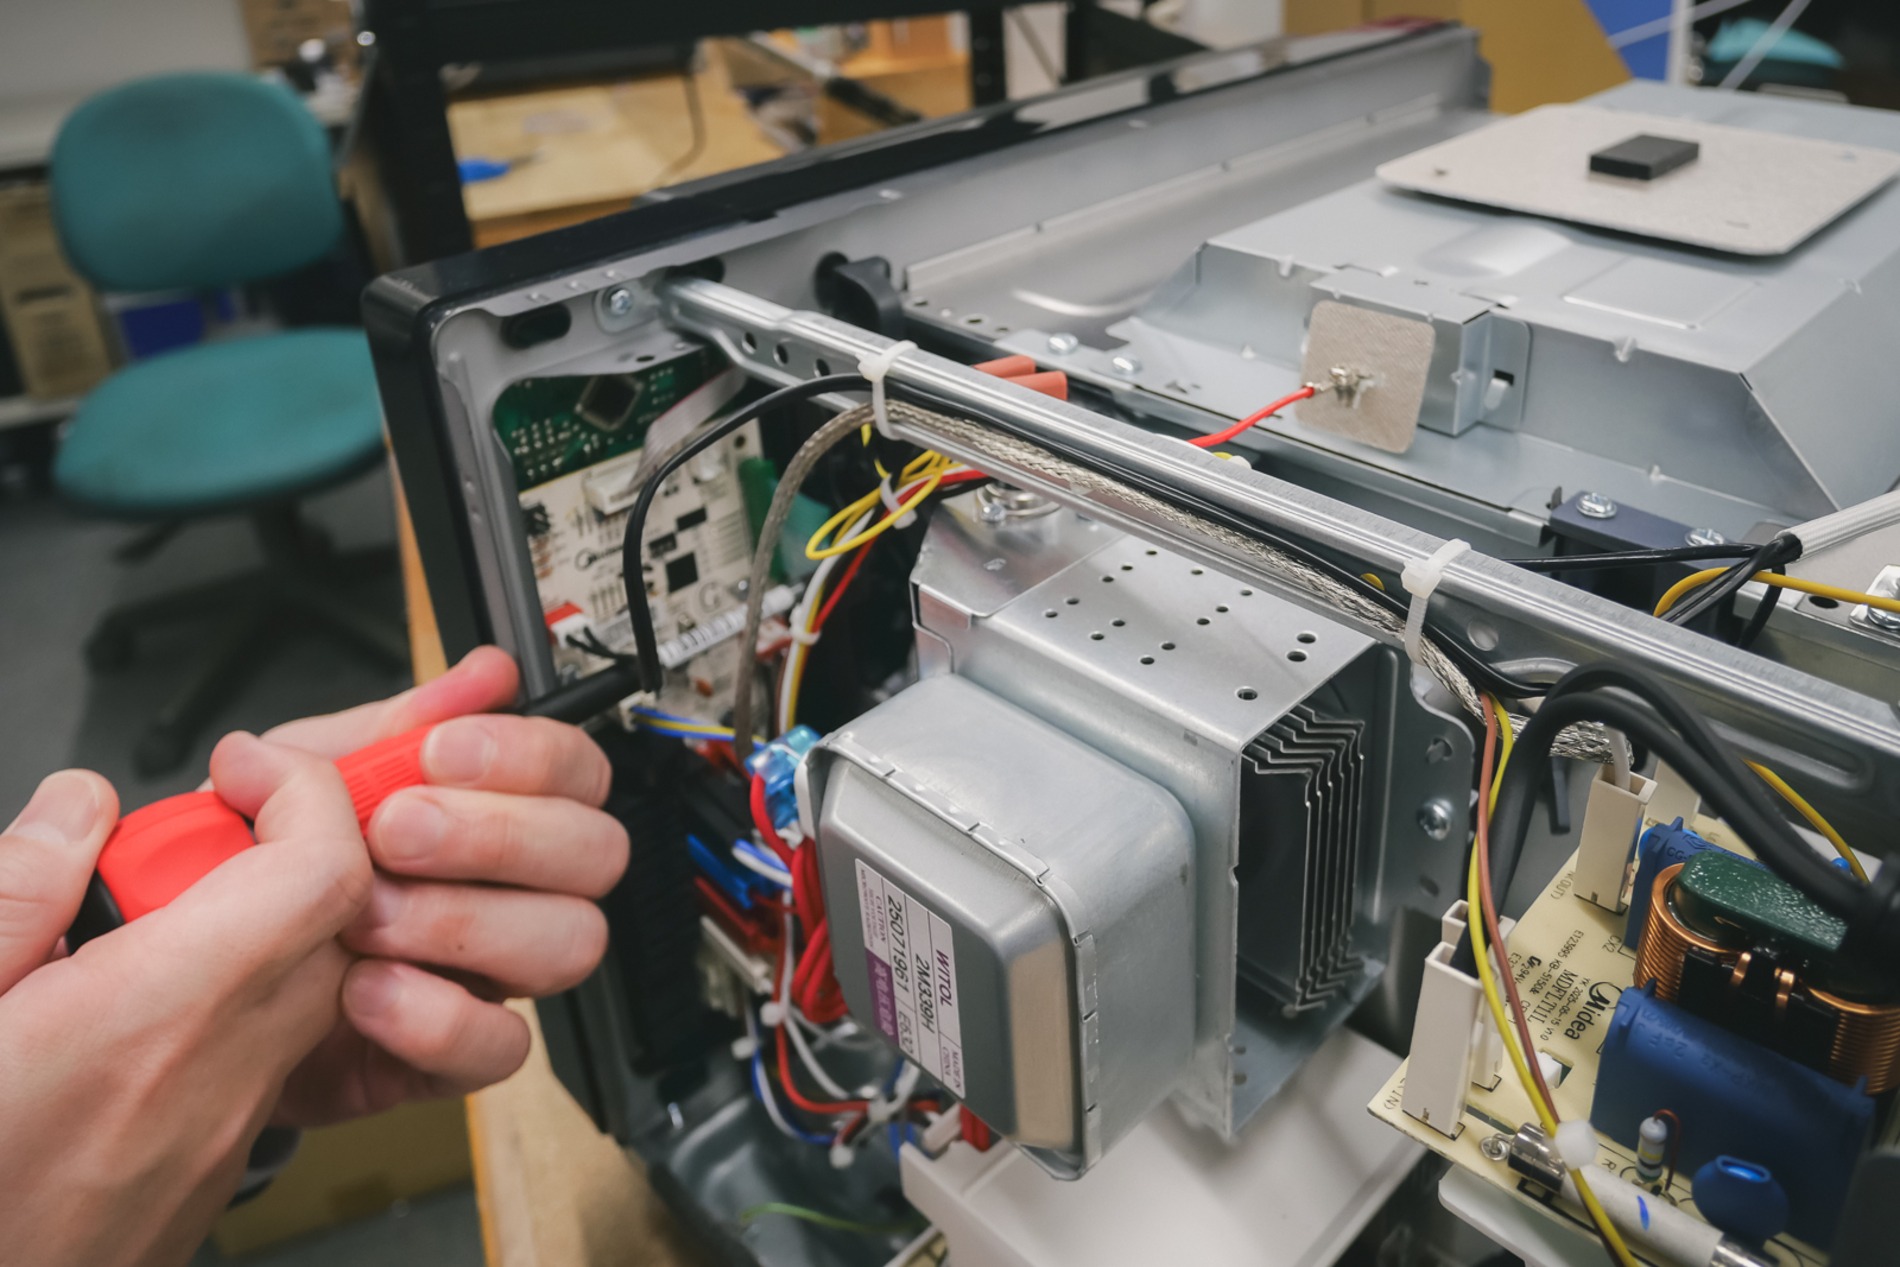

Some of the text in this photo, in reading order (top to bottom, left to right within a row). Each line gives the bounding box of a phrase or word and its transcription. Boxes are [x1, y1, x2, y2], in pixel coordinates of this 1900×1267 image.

[875, 895, 886, 942] CAUTION
[1602, 934, 1622, 953] CX2
[887, 894, 914, 1055] 25071961 E632
[915, 953, 935, 1034] 2M339H
[936, 949, 953, 1007] WITOL
[1527, 969, 1578, 1023] MDFLT11L
[1564, 982, 1620, 1040] Midea
[1601, 1158, 1617, 1173] R
